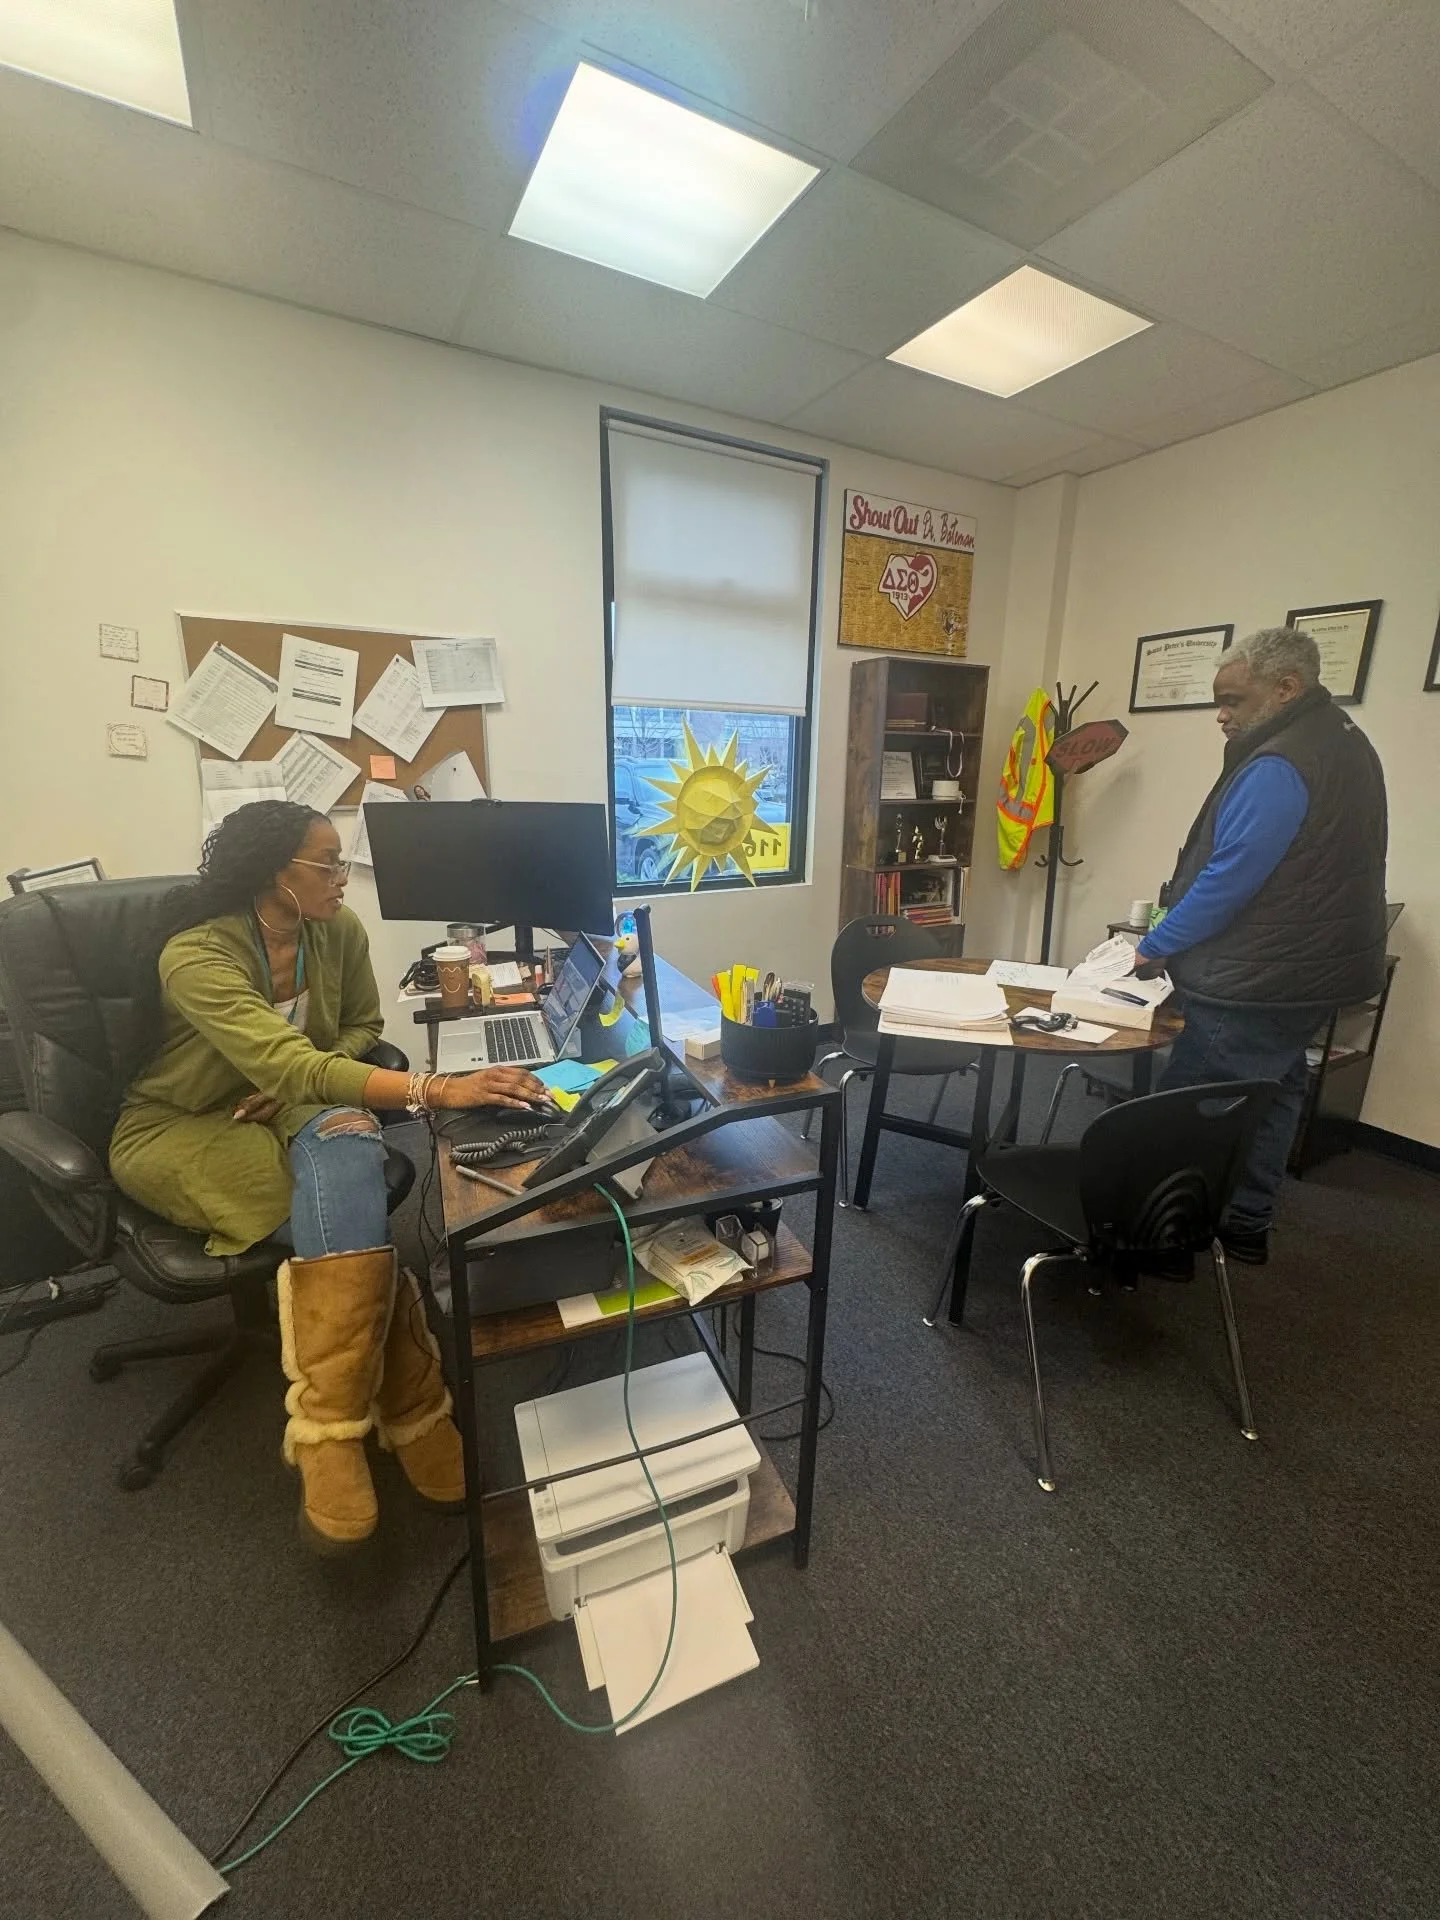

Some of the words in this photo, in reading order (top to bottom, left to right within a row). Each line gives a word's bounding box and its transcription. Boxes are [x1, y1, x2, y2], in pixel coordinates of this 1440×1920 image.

[850, 495, 892, 530] Shout
[893, 506, 919, 535] Out
[891, 590, 909, 600] 1913
[1186, 639, 1218, 648] University
[1055, 736, 1118, 758] SLOW
